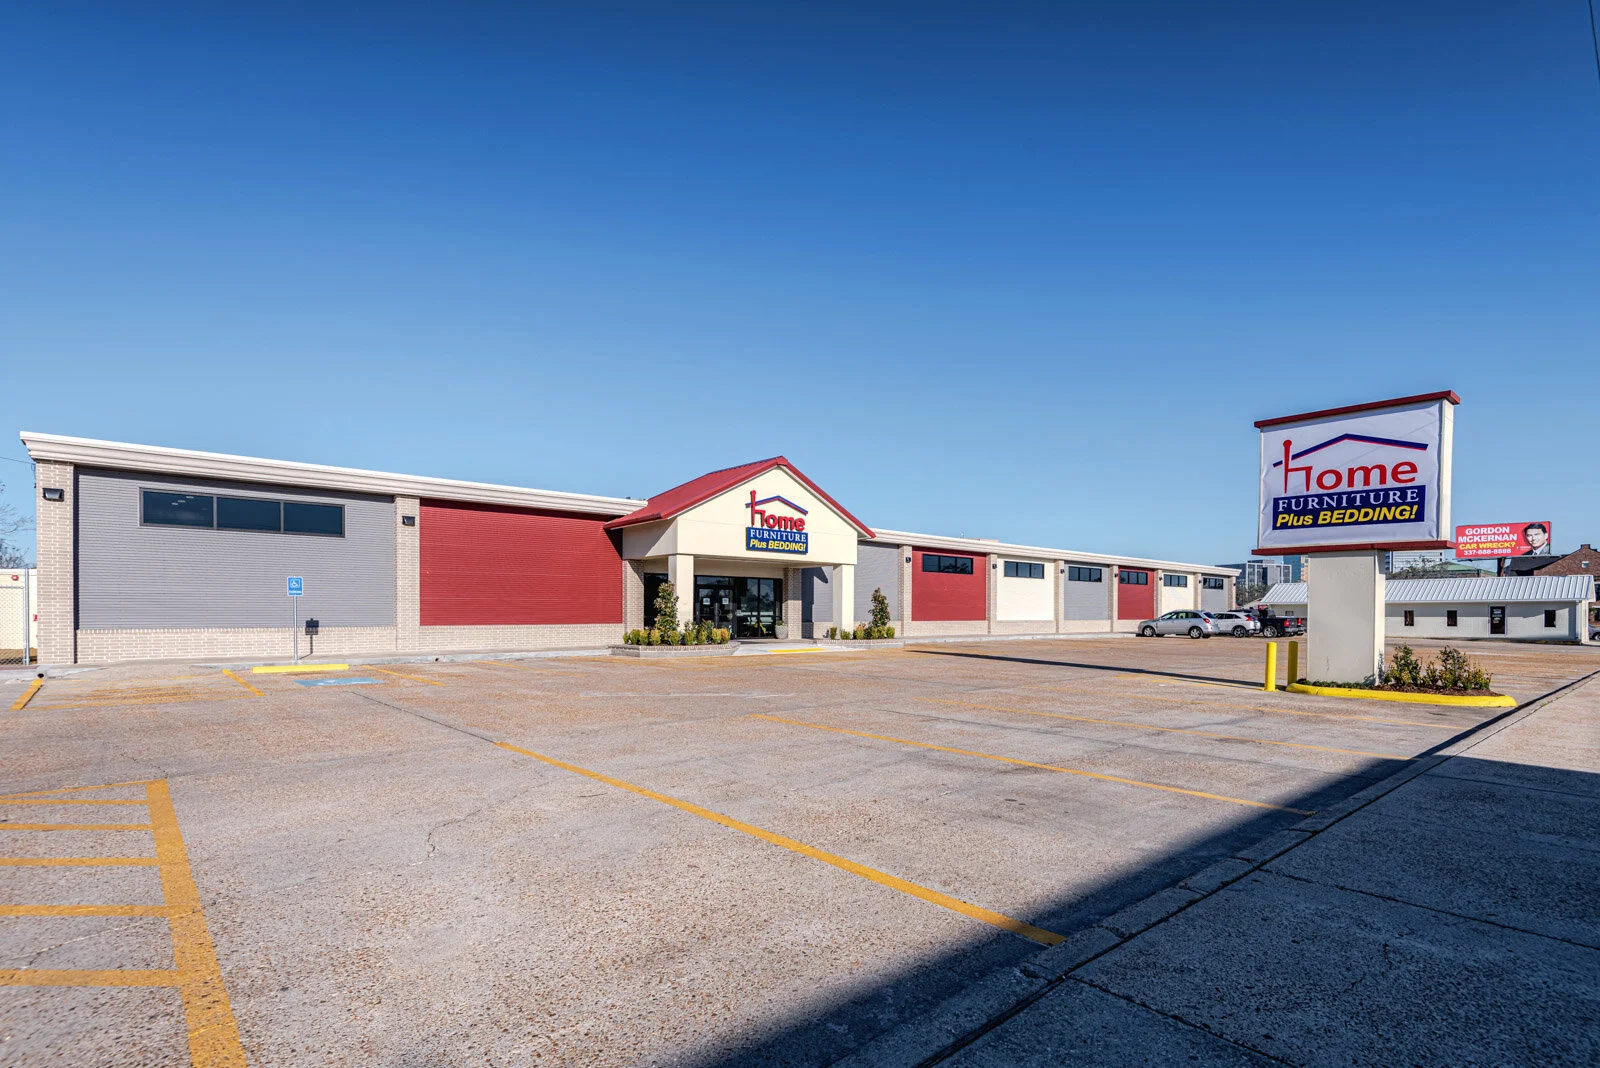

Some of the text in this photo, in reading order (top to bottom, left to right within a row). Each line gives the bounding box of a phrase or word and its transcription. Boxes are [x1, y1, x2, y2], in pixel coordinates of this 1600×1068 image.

[1282, 439, 1418, 494] home
[1278, 489, 1419, 512] FURNITURE
[751, 490, 806, 531] home
[1276, 505, 1418, 527] Plus BEDDING!
[750, 530, 806, 542] FURNITURE
[1458, 534, 1517, 543] MCKERNAN
[1465, 527, 1510, 535] GORDON
[750, 539, 806, 551] Plus BEDDING!
